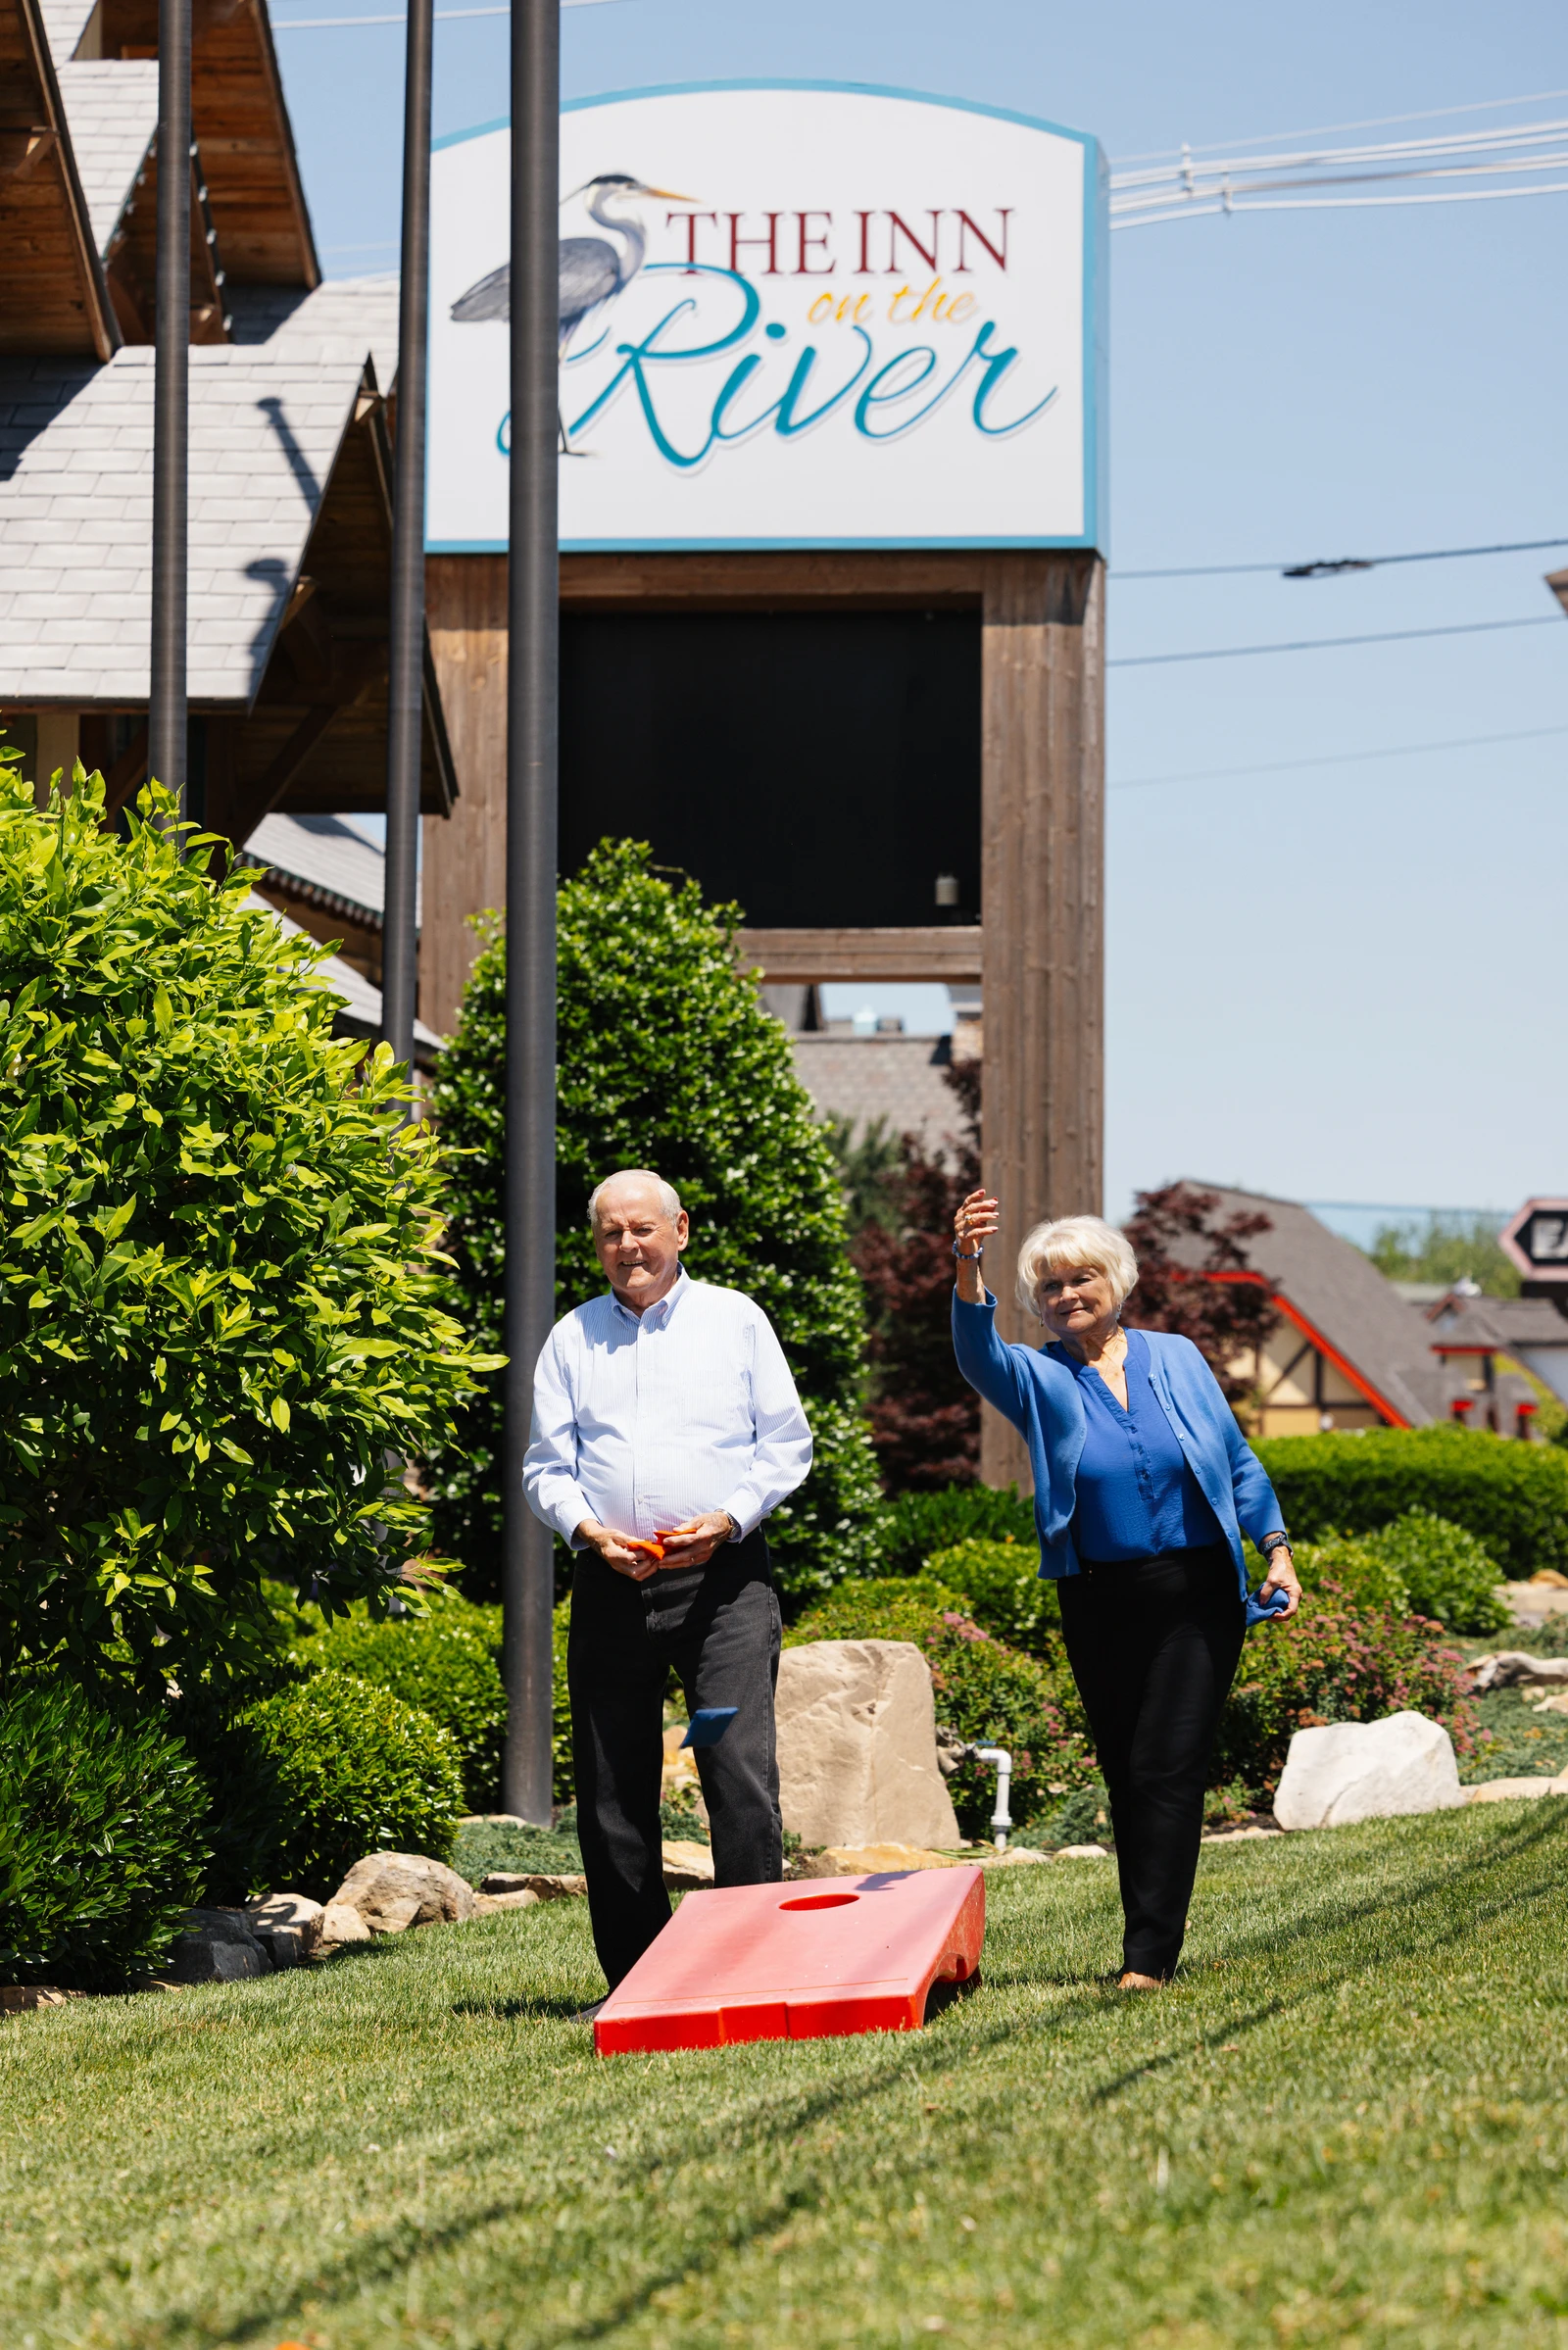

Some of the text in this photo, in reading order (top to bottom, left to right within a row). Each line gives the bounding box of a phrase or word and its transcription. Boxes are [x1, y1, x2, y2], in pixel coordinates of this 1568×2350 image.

[666, 208, 1013, 276] THE INN
[807, 276, 978, 323] on the
[496, 262, 1058, 467] River
